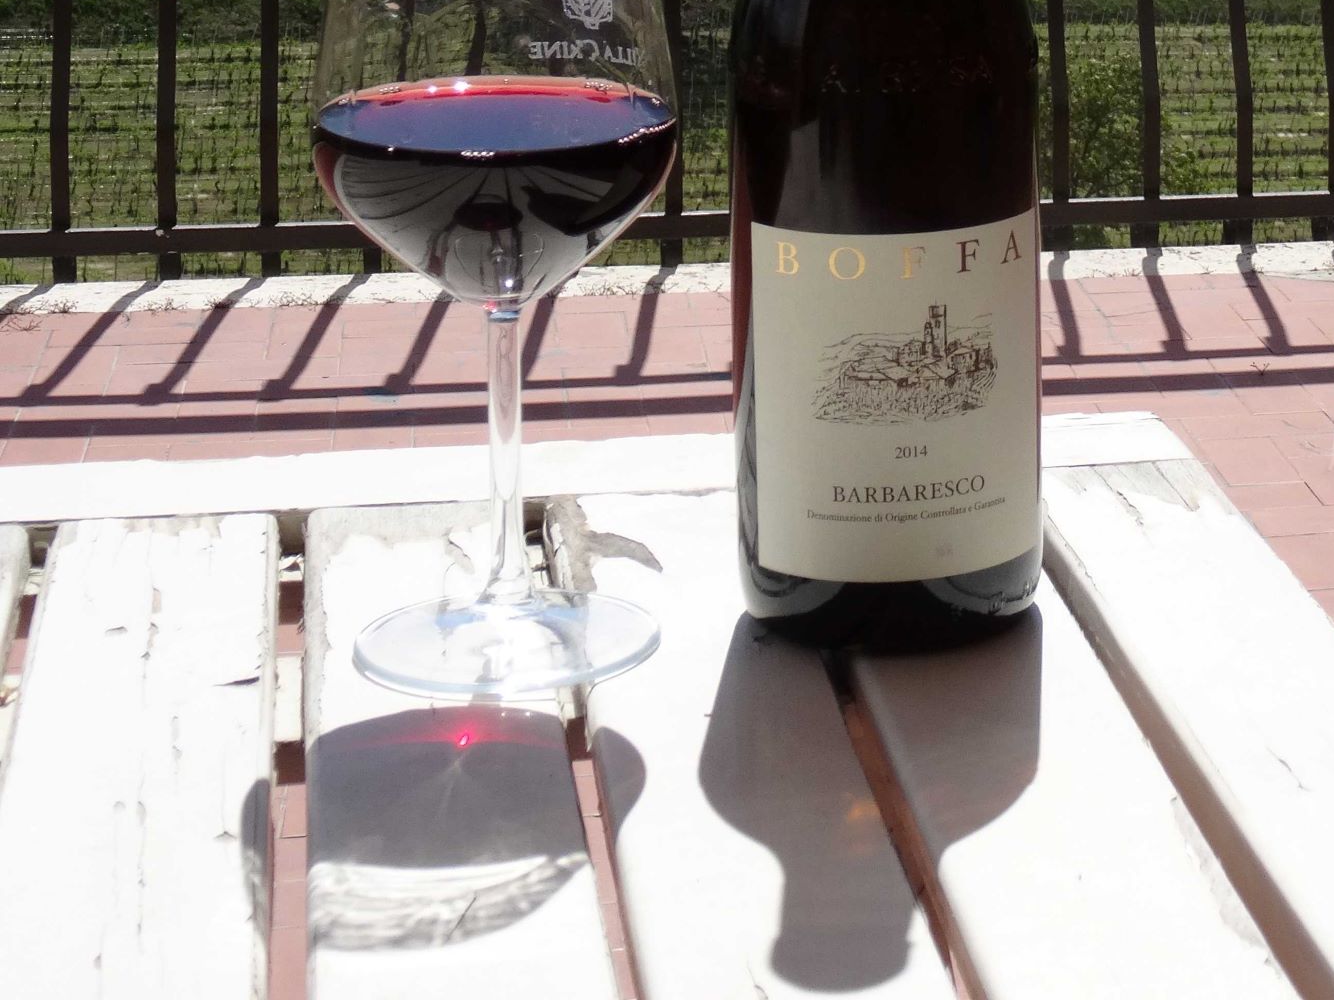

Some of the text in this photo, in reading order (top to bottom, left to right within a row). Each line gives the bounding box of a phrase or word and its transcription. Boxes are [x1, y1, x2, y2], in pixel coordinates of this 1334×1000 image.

[775, 229, 1022, 280] BOFFA
[895, 445, 928, 459] 2014
[832, 474, 985, 504] BARBARESCO
[807, 509, 872, 523] Denominazione
[874, 513, 883, 523] di
[885, 512, 918, 524] Origine
[920, 506, 966, 520] Controllata
